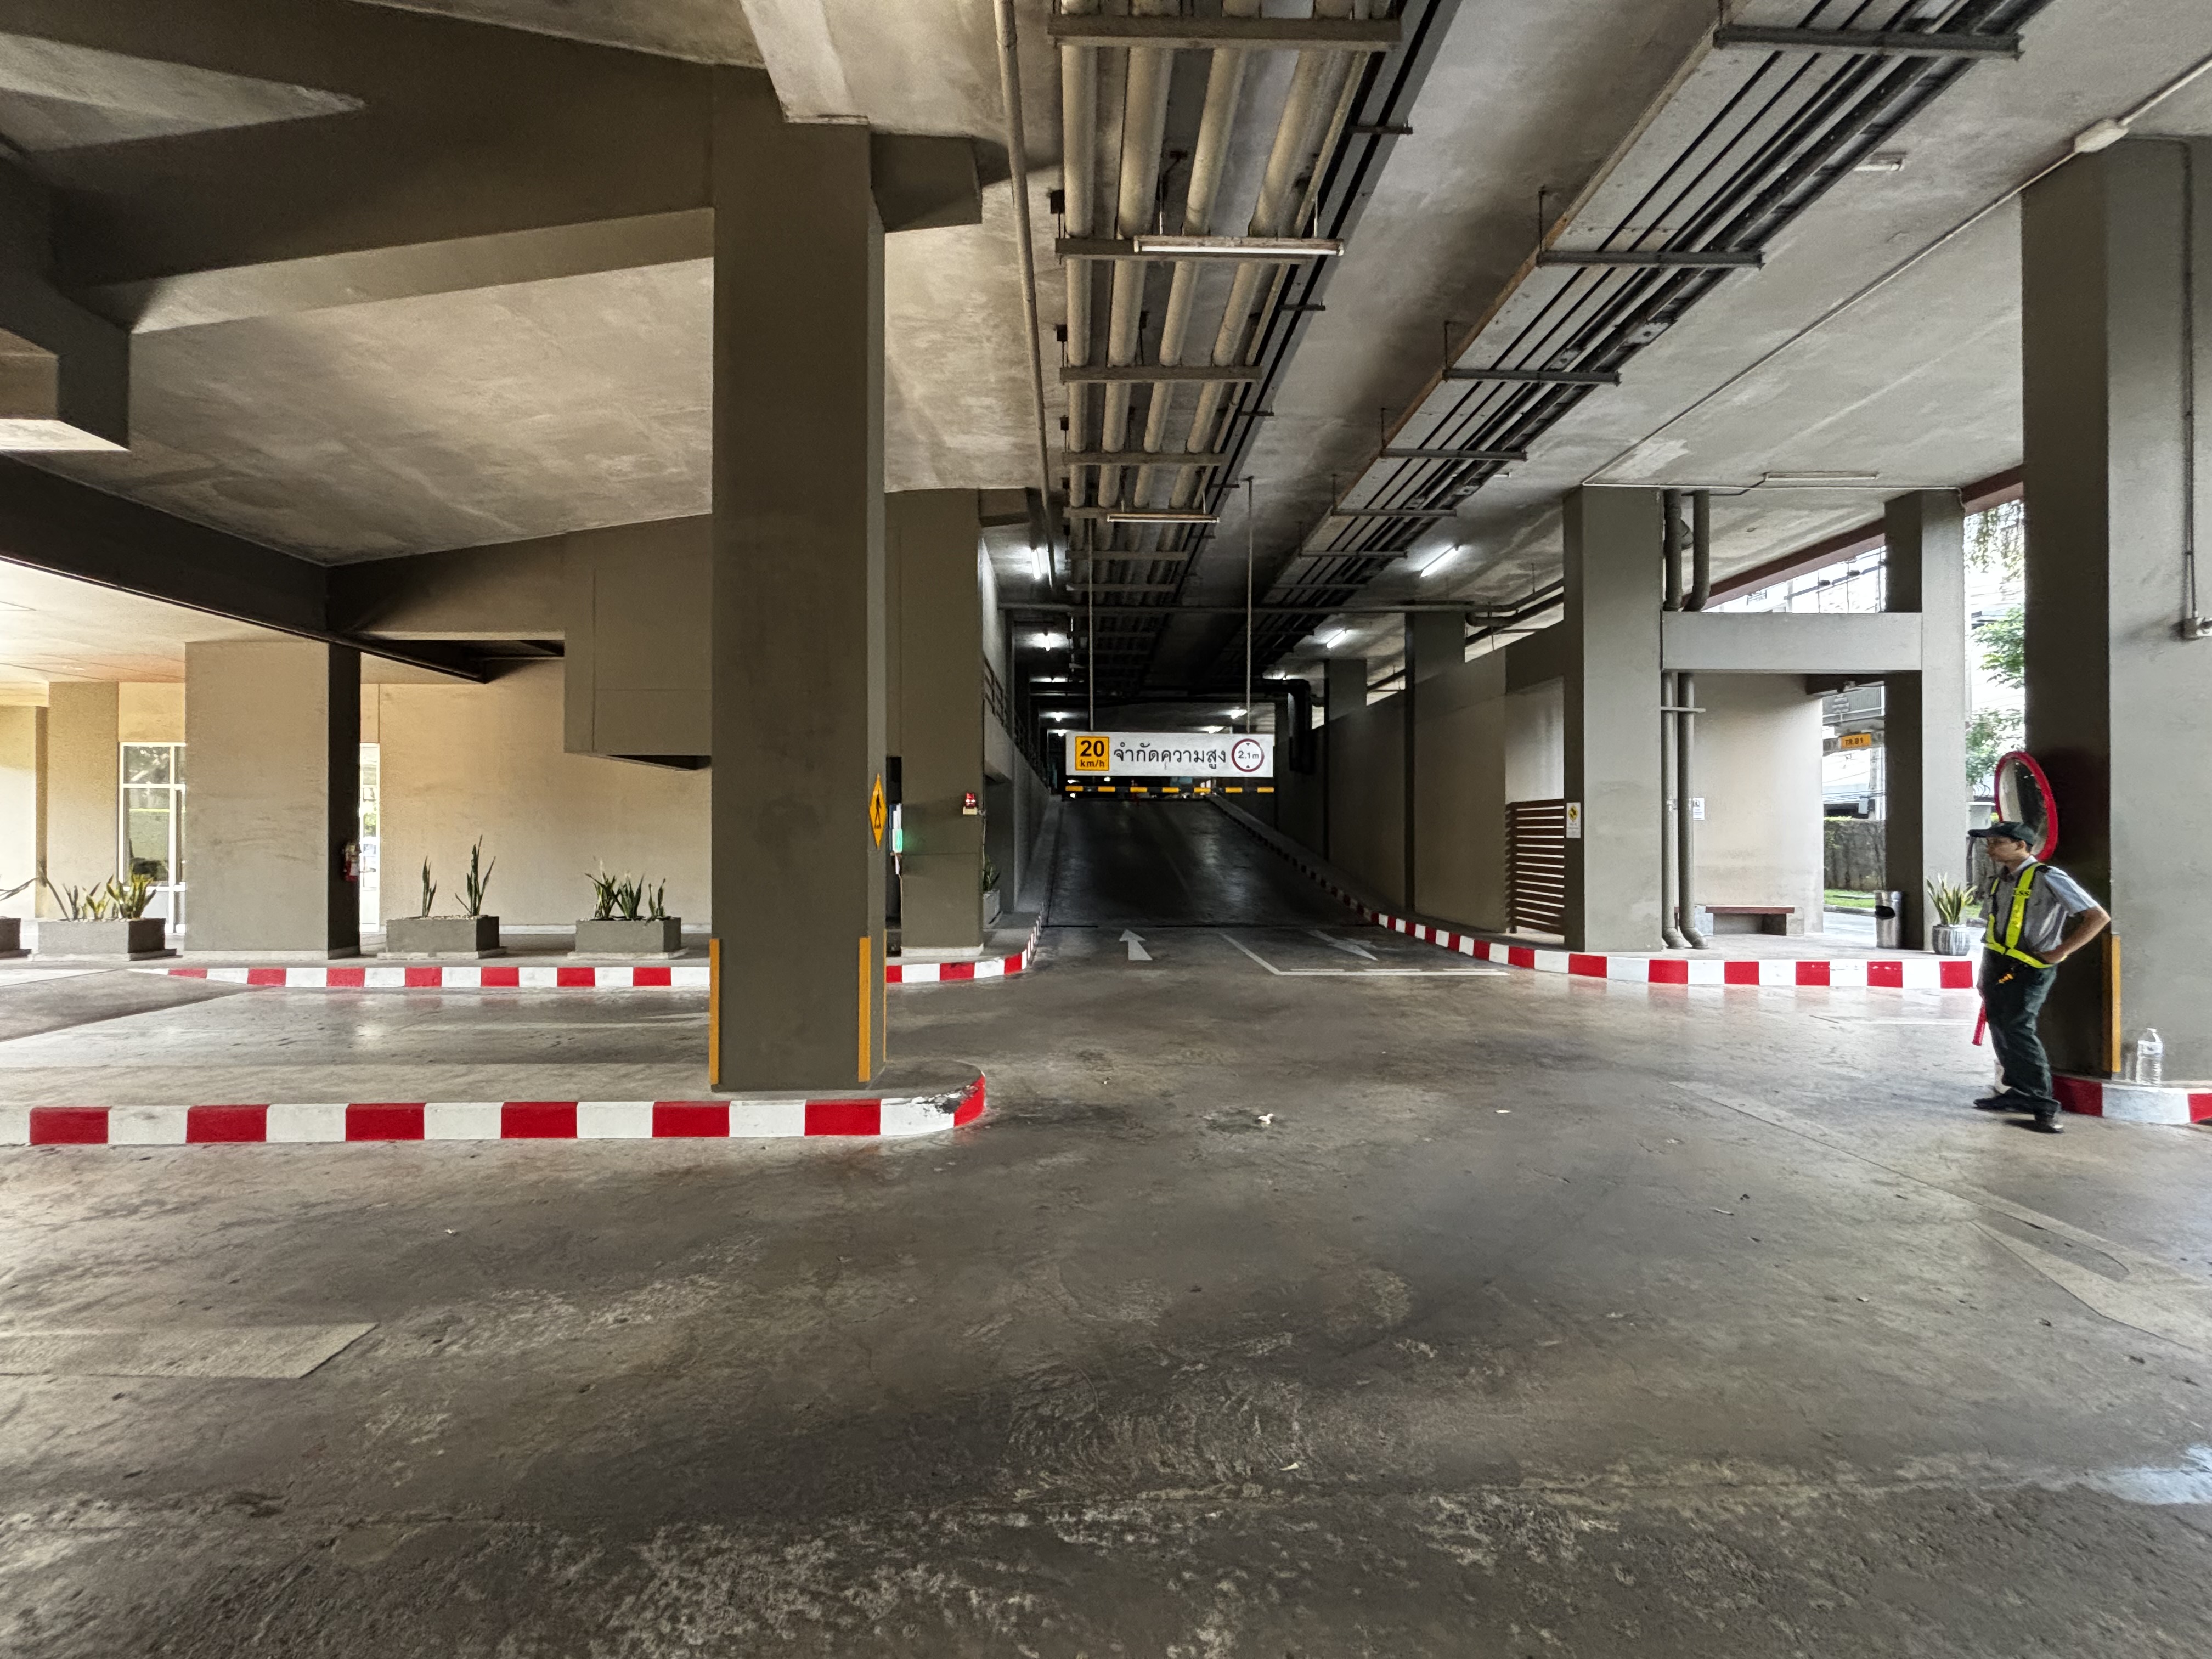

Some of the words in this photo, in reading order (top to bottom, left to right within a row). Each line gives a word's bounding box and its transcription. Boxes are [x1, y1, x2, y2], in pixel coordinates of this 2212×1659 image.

[1080, 740, 1105, 757] 20
[1113, 742, 1226, 769] จำกัดความสูง
[1080, 759, 1105, 768] km/h
